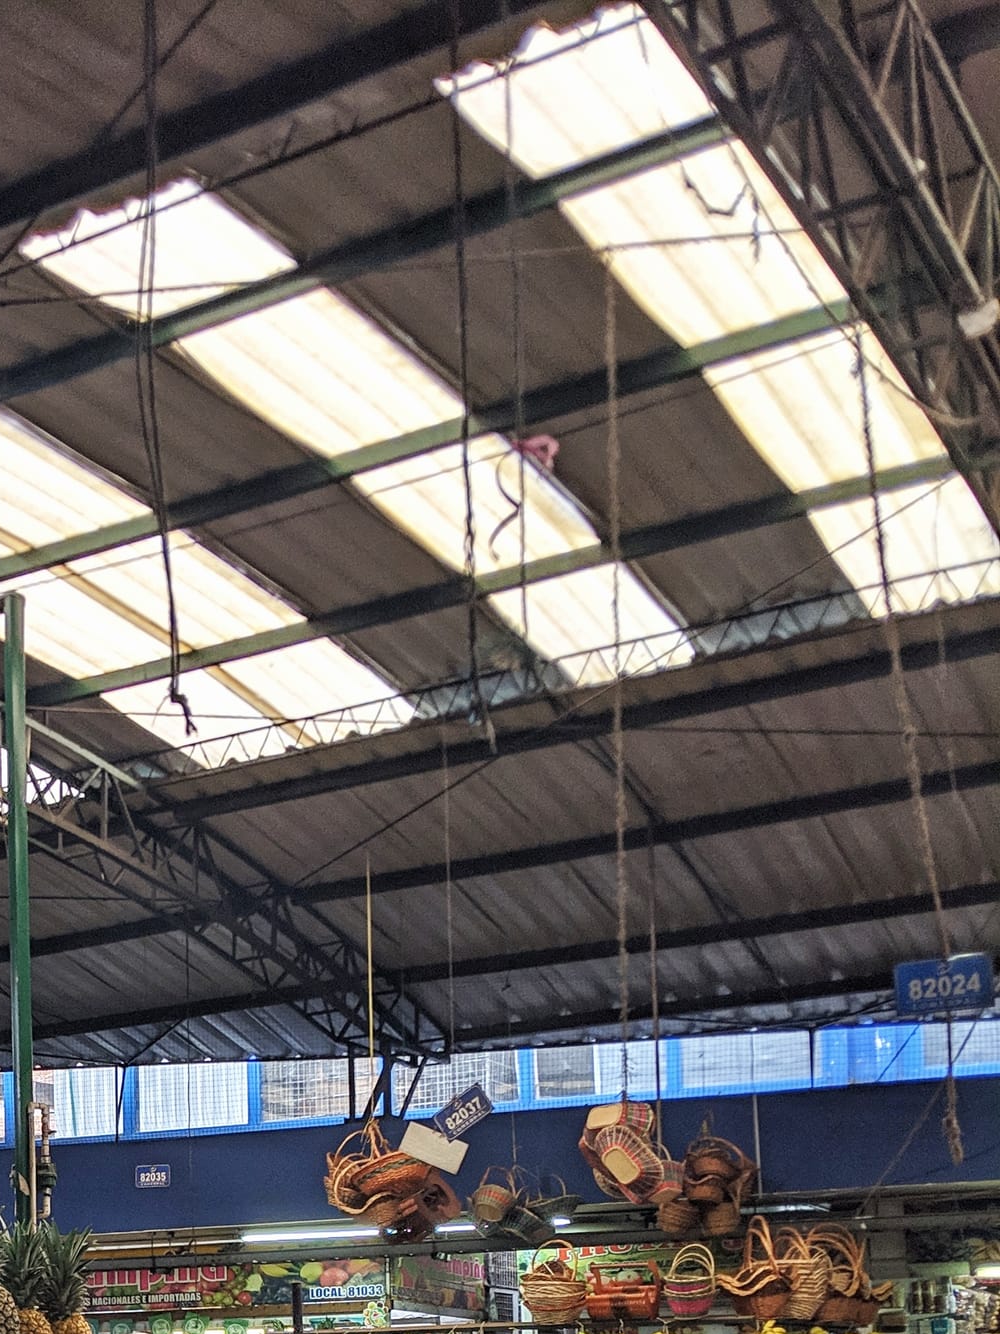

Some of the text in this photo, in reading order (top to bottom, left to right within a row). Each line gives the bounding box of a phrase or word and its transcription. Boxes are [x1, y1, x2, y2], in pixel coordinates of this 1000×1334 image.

[909, 971, 981, 999] 82024
[445, 1096, 481, 1130] 82037
[140, 1172, 167, 1182] 82035
[348, 1285, 383, 1297] 81033
[92, 1295, 140, 1306] NACIONALES
[142, 1295, 147, 1303] E
[148, 1293, 201, 1303] IMPORTADAS
